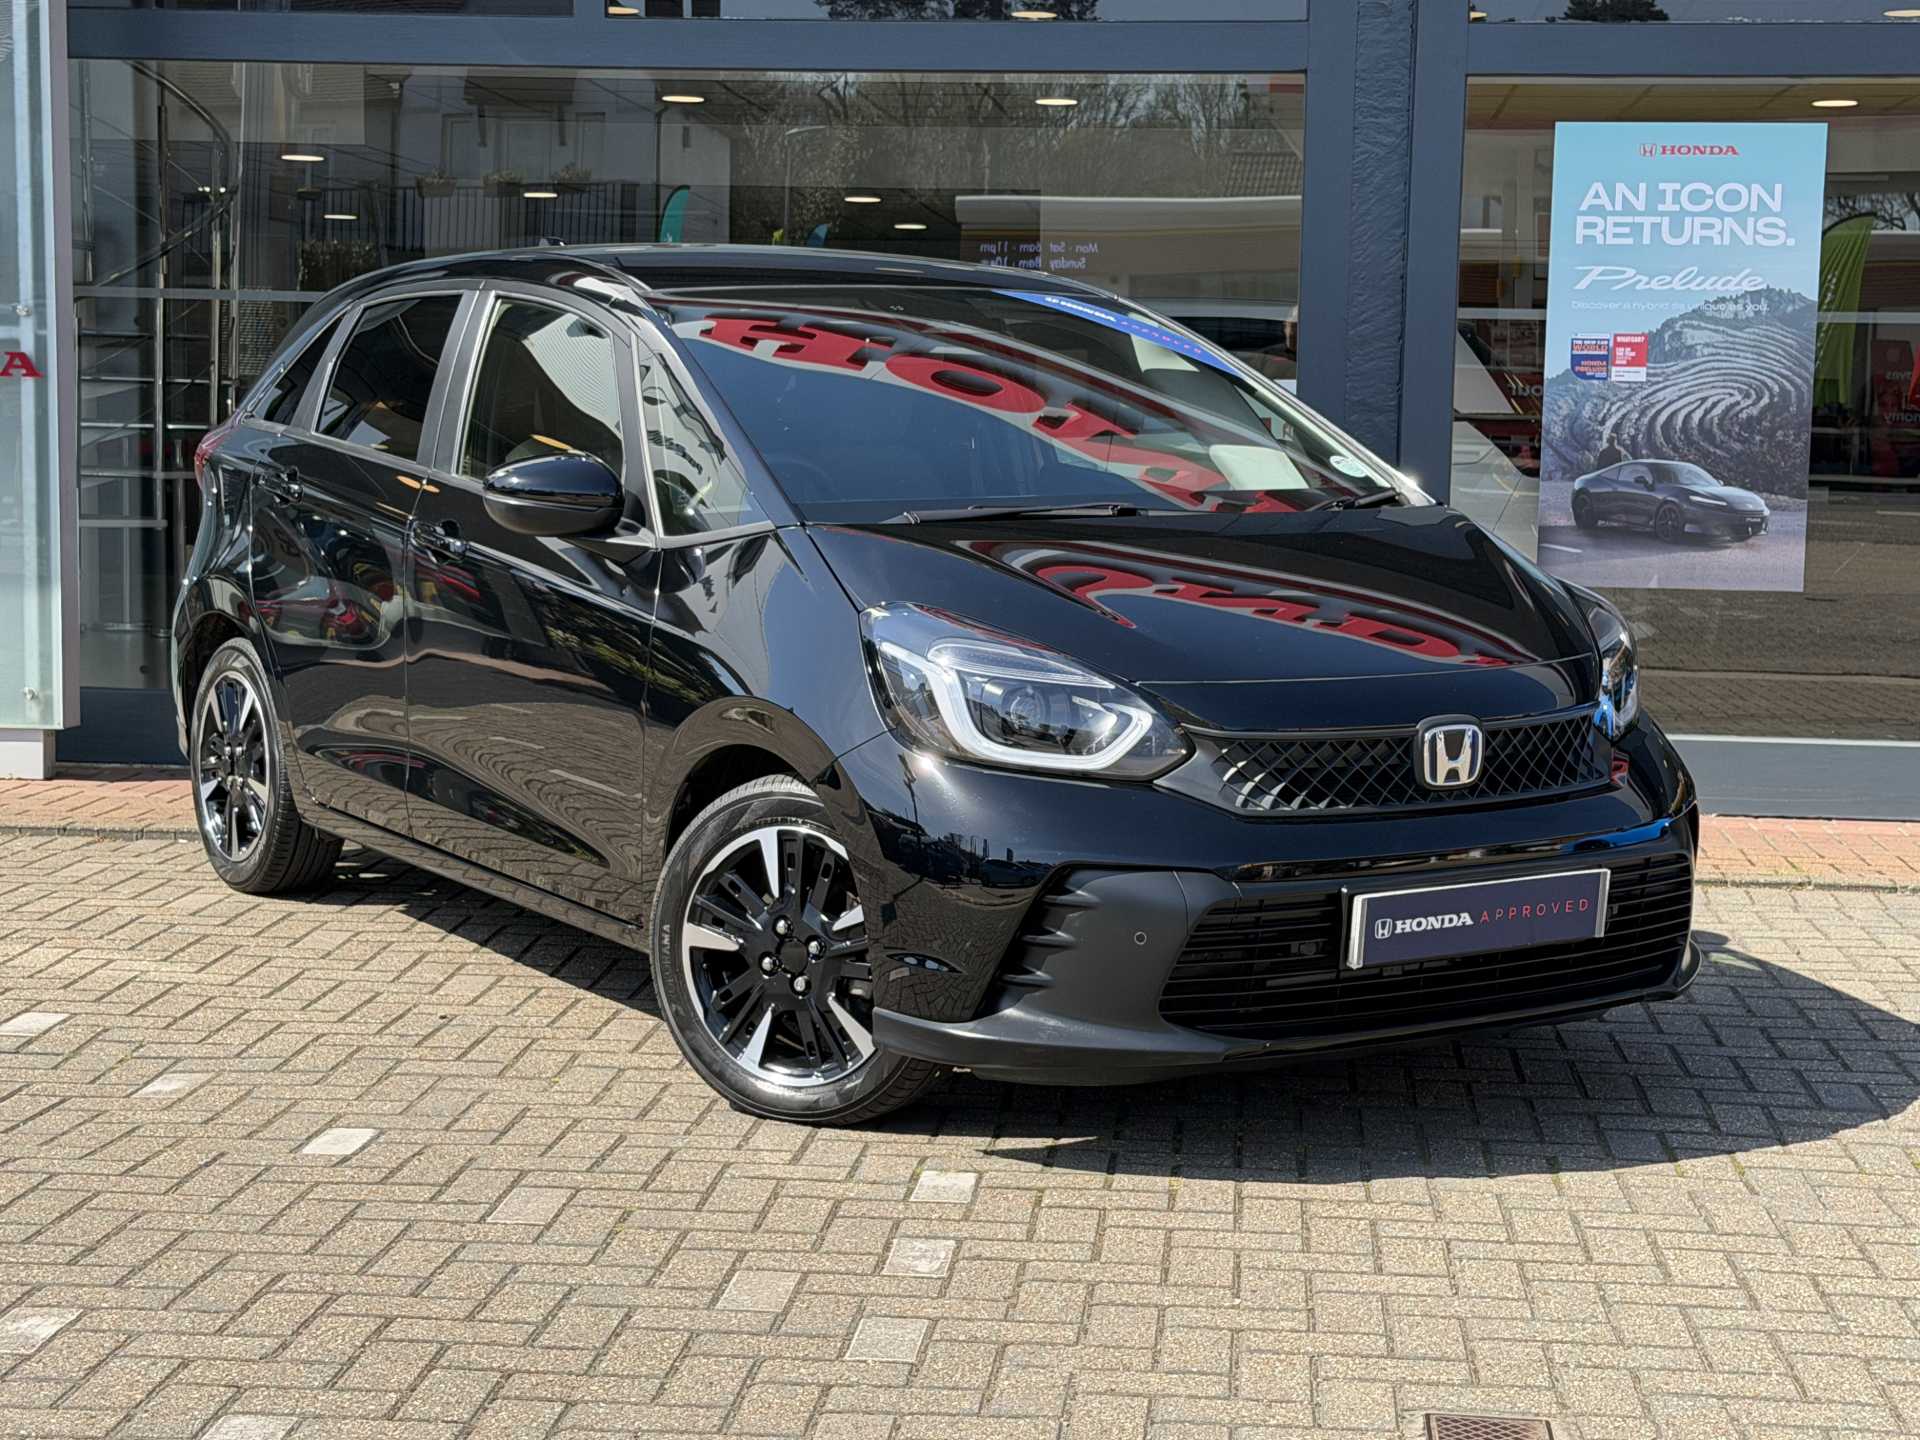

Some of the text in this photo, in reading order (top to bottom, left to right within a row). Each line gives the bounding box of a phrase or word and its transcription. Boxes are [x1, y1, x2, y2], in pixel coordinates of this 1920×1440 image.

[1661, 144, 1740, 155] HONDA
[1579, 181, 1782, 212] AN ICON
[1575, 215, 1796, 246] RETURNS.
[1572, 265, 1767, 291] Prelude
[1571, 301, 1620, 309] Discover
[1394, 898, 1590, 933] HONDA APPROVED
